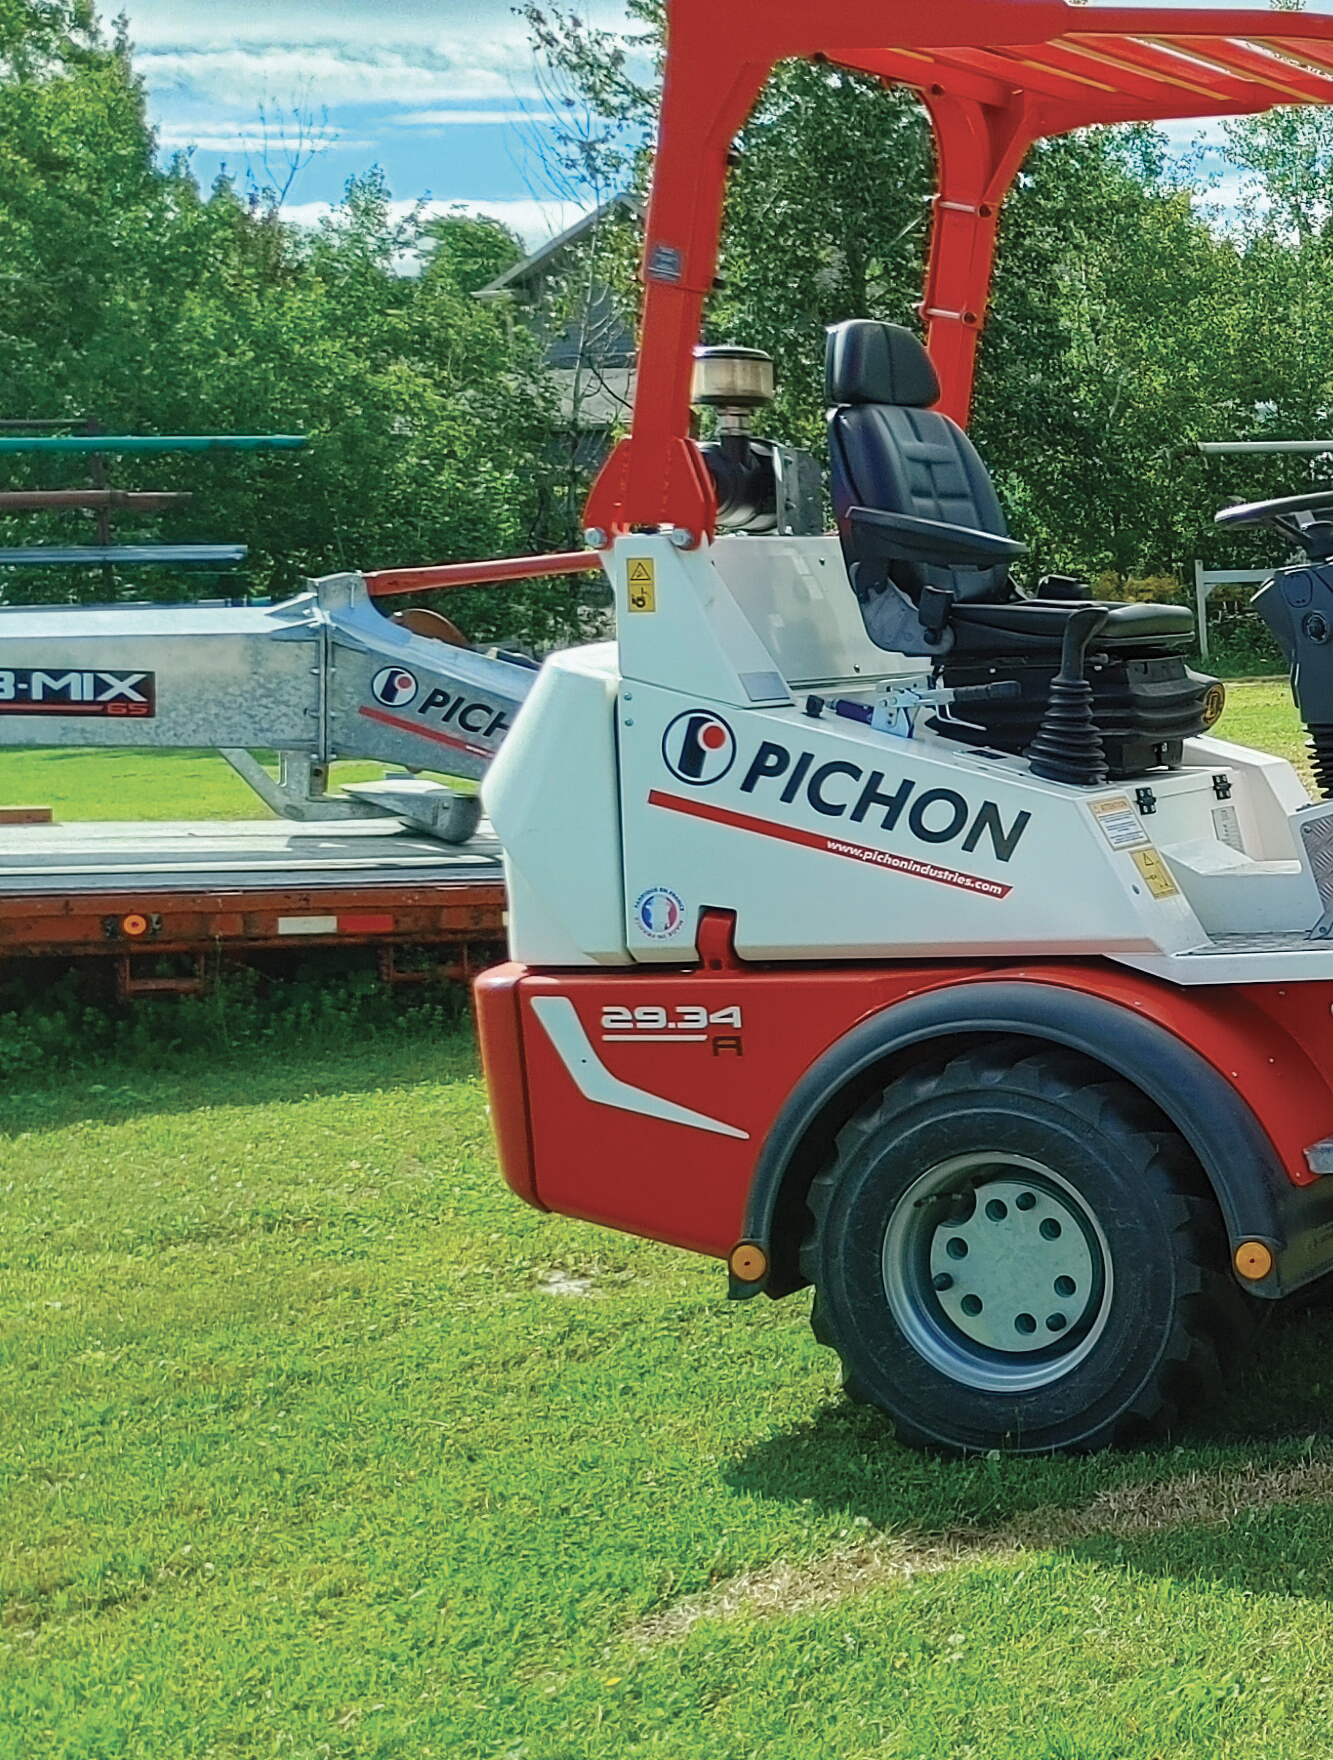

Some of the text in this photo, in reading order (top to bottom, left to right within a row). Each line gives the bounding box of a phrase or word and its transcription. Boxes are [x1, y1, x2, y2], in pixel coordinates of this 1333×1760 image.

[107, 702, 149, 715] 65
[740, 741, 1032, 862] PICHON
[826, 840, 1002, 895] www.pichonindustries.com
[601, 1006, 742, 1029] 29.34
[713, 1036, 743, 1057] A
